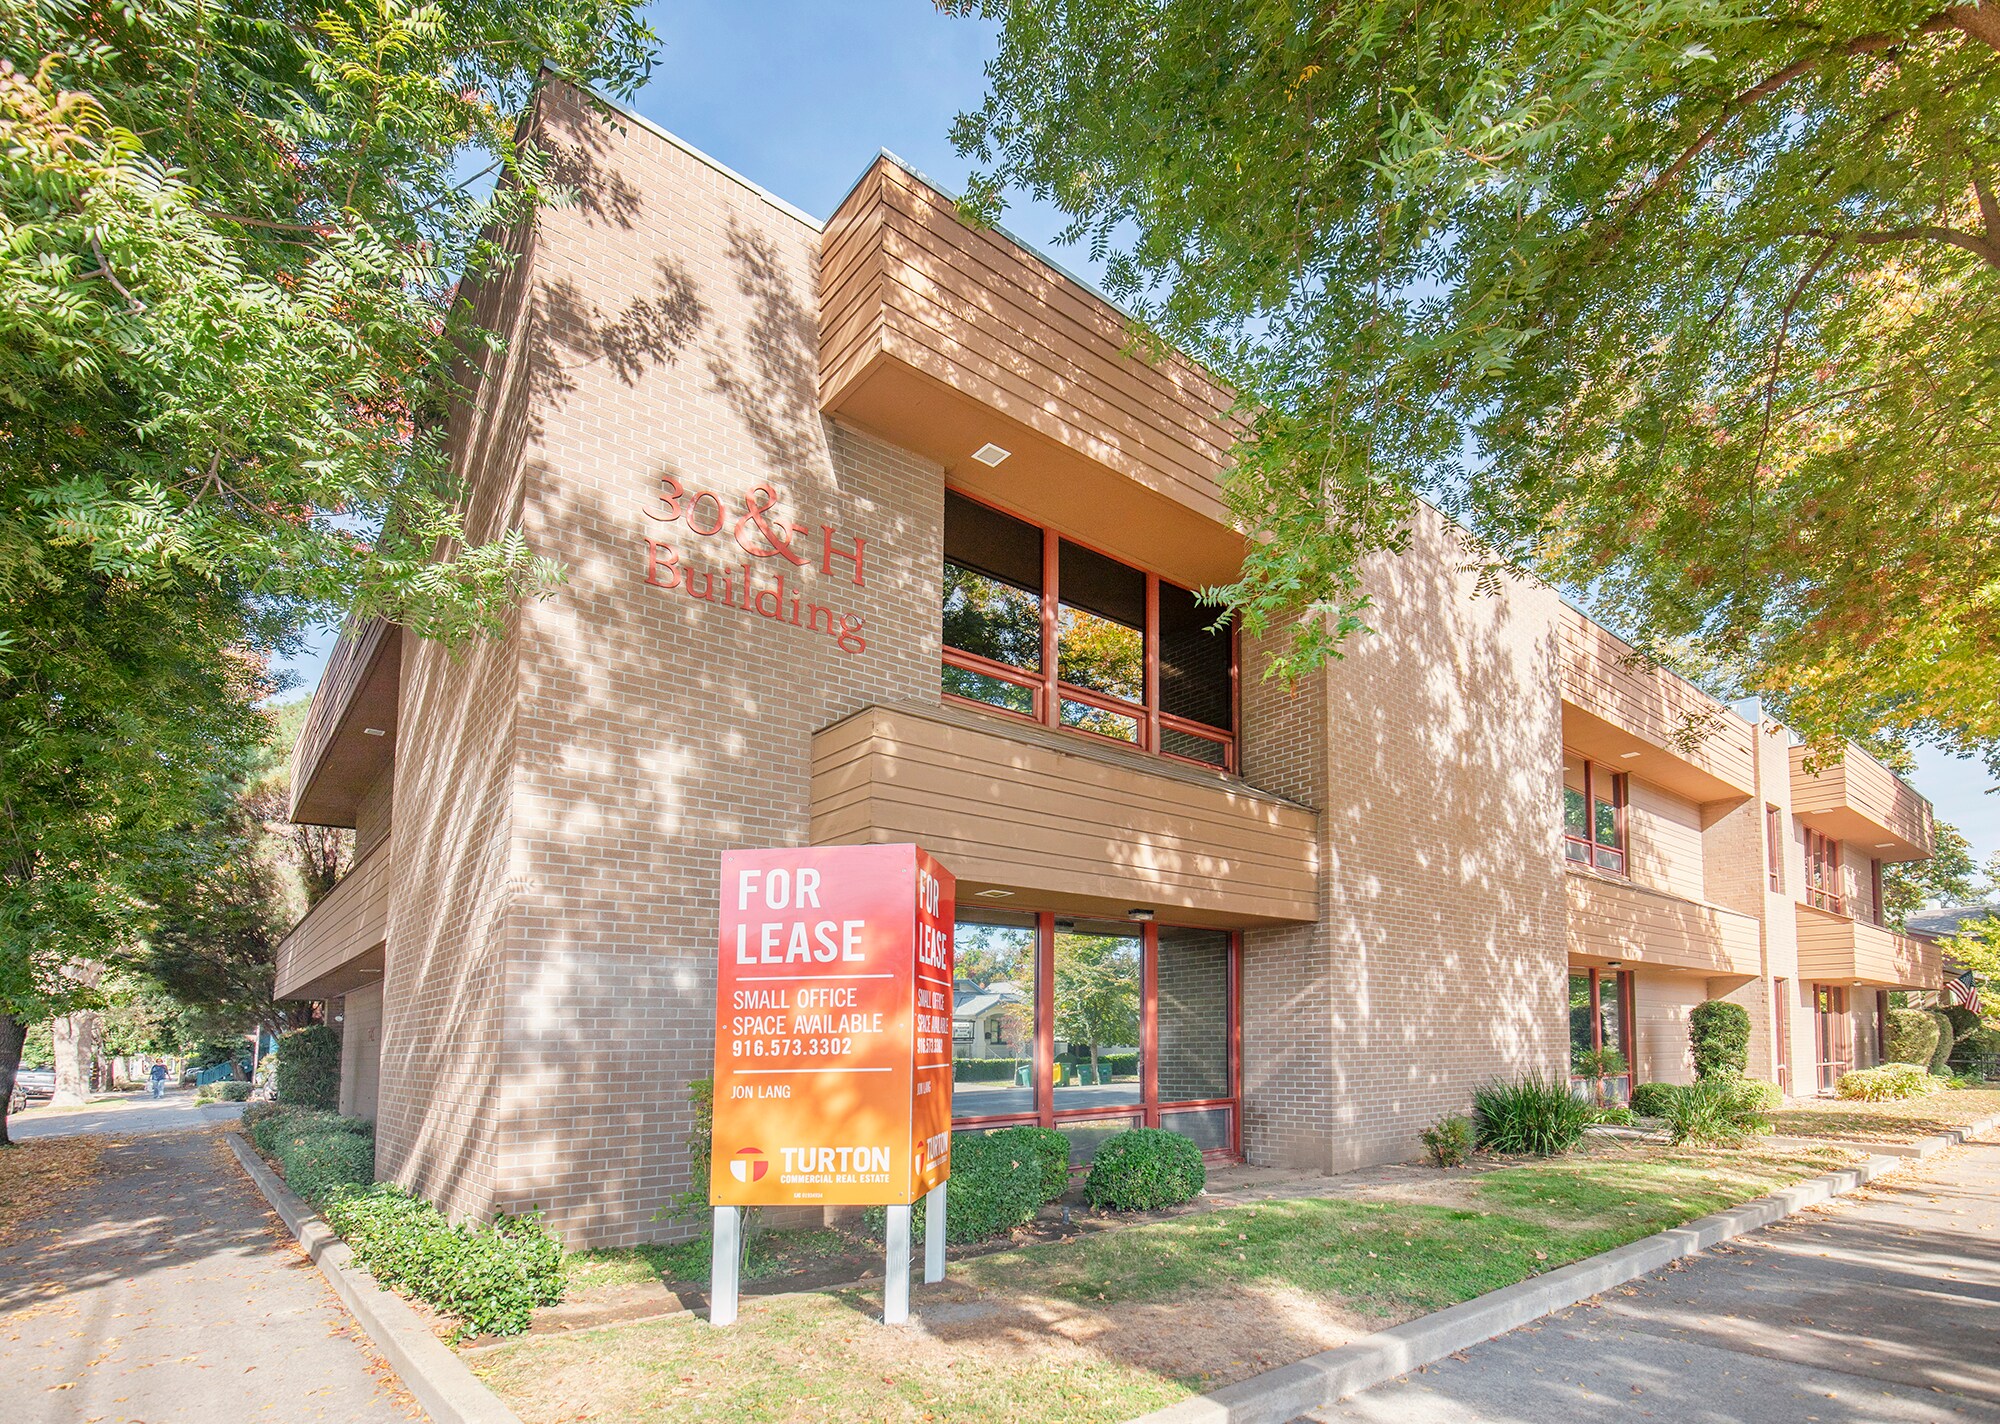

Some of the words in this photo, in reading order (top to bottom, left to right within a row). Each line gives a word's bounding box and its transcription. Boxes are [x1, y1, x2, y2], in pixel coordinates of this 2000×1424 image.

[644, 538, 866, 654] Building
[738, 867, 821, 910] FOR
[919, 868, 939, 918] FOR
[736, 920, 865, 965] LEASE
[919, 922, 947, 970] LEASE
[733, 990, 790, 1010] SMALL
[797, 988, 857, 1008] OFFICE
[732, 1015, 789, 1036] SPACE
[793, 1013, 883, 1034] AVAILABLE
[732, 1038, 851, 1057] 916.573.3302
[730, 1085, 754, 1099] JON
[758, 1085, 791, 1099] LANG
[780, 1146, 890, 1173] TURTON
[780, 1174, 833, 1184] COMMERCIAL
[836, 1174, 857, 1183] REAL
[860, 1174, 890, 1183] ESTATE
